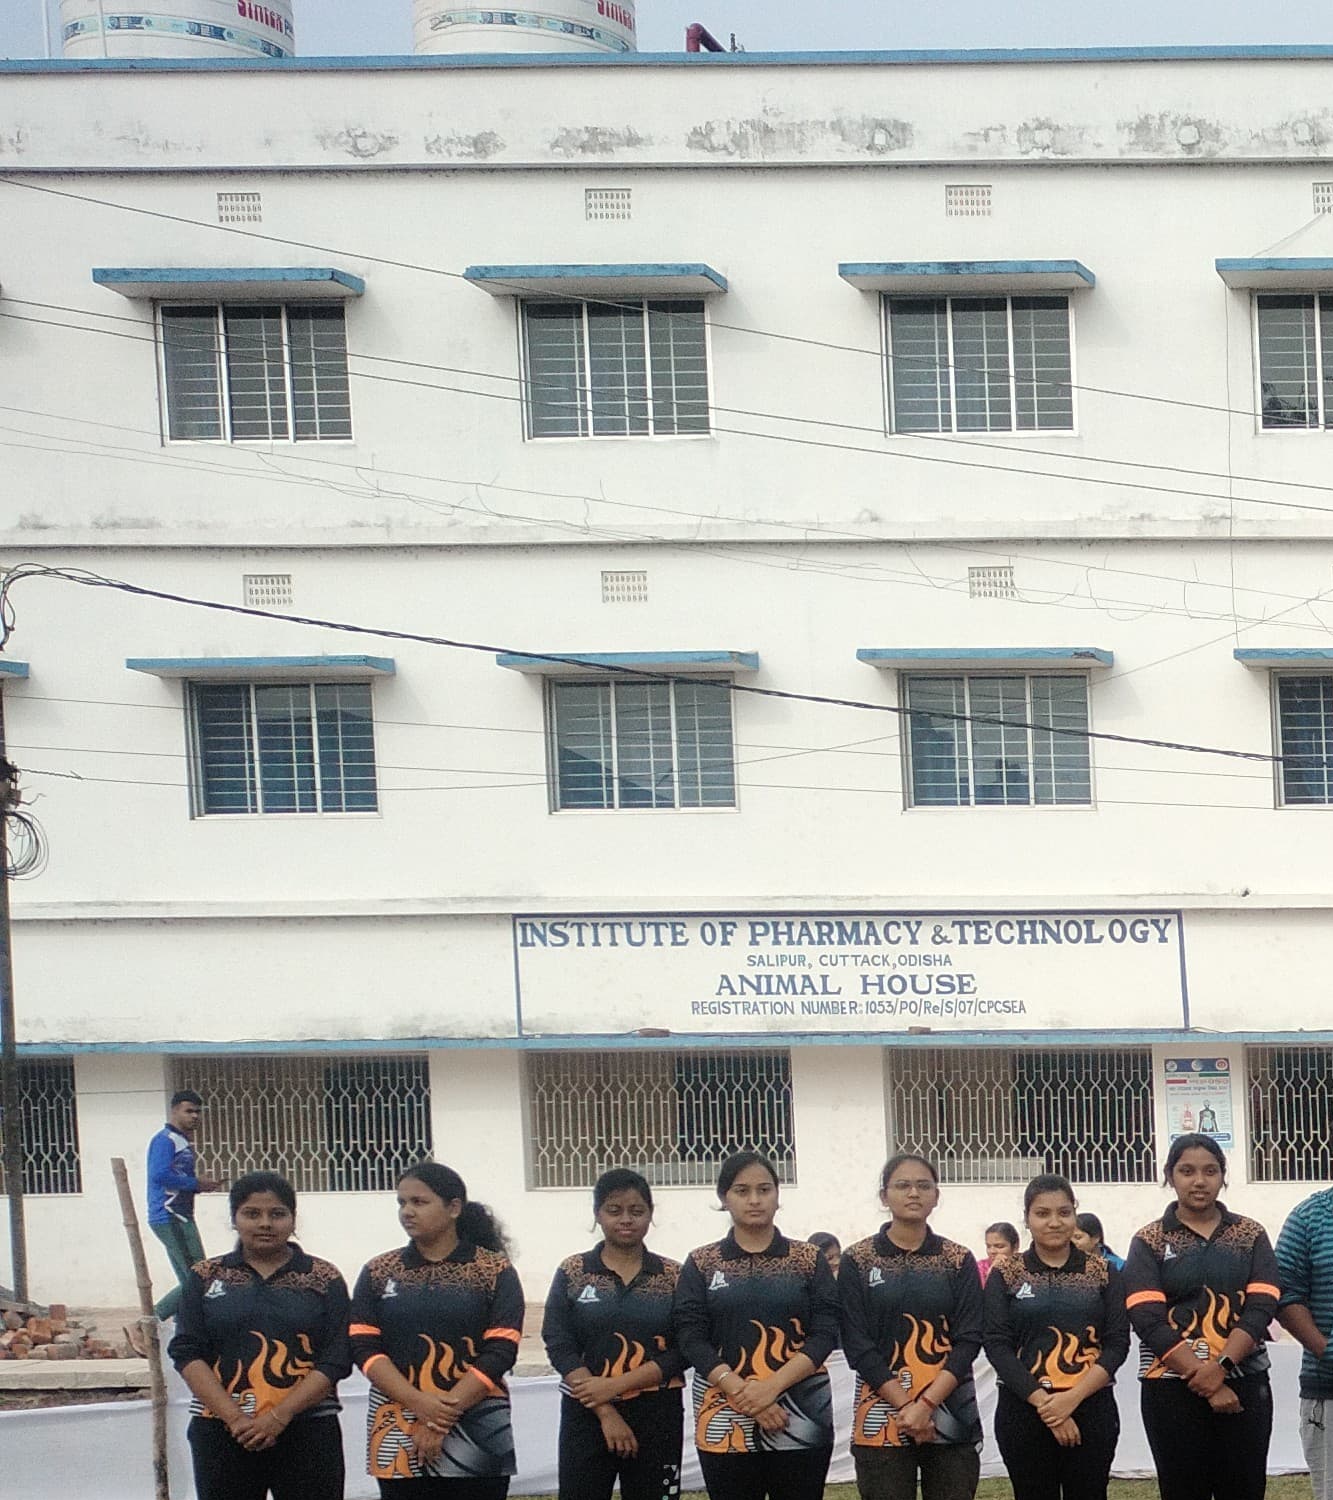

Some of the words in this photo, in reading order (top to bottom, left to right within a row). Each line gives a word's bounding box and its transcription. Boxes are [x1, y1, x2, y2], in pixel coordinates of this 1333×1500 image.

[519, 920, 690, 948] INSTITUTE
[699, 920, 738, 947] OF
[748, 919, 923, 947] PHARMACY
[746, 954, 813, 969] SALIPUR,
[715, 973, 842, 997] ANIMAL
[860, 973, 978, 996] HOUSE
[691, 1000, 795, 1016] REGISTRATION
